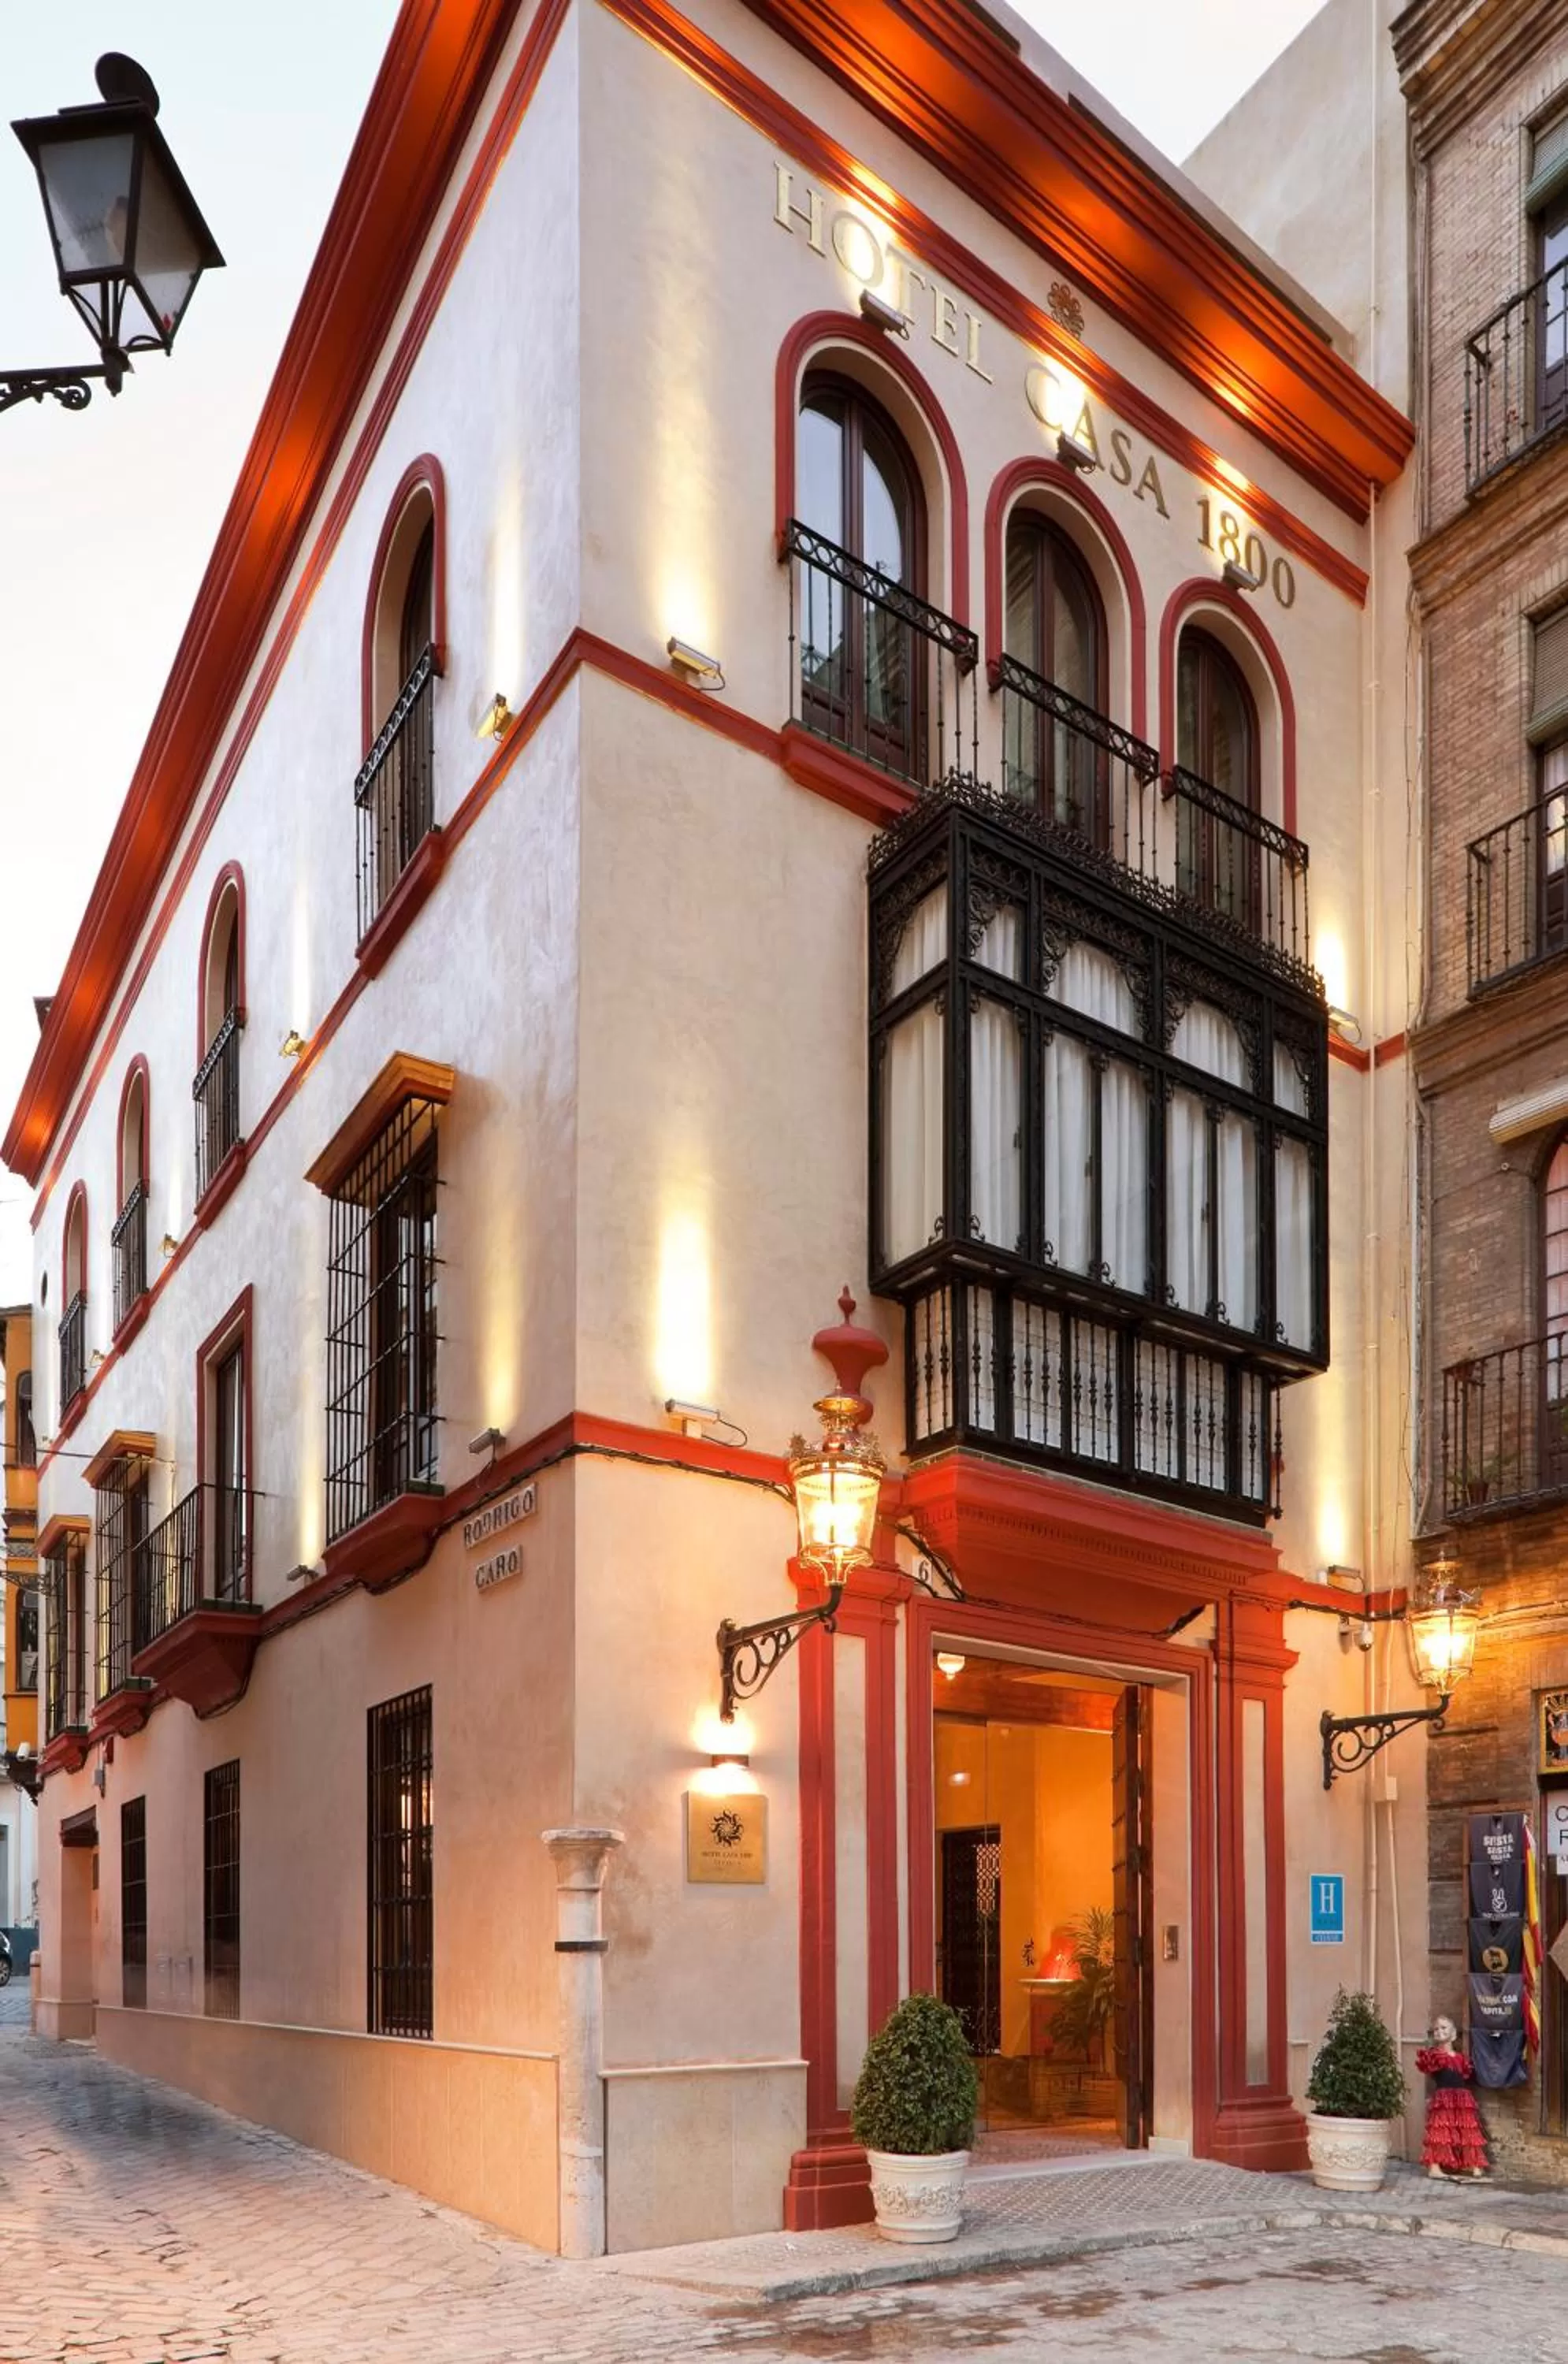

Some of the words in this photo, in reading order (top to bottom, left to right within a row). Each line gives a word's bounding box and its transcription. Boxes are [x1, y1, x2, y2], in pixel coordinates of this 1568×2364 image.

[774, 161, 993, 385] HOTEL
[1025, 361, 1170, 520] CASA
[1196, 496, 1296, 609] 1800
[463, 1489, 533, 1545] RODRIGO
[475, 1550, 518, 1589] CARO
[918, 1559, 929, 1582] 6
[1318, 1882, 1337, 1914] H
